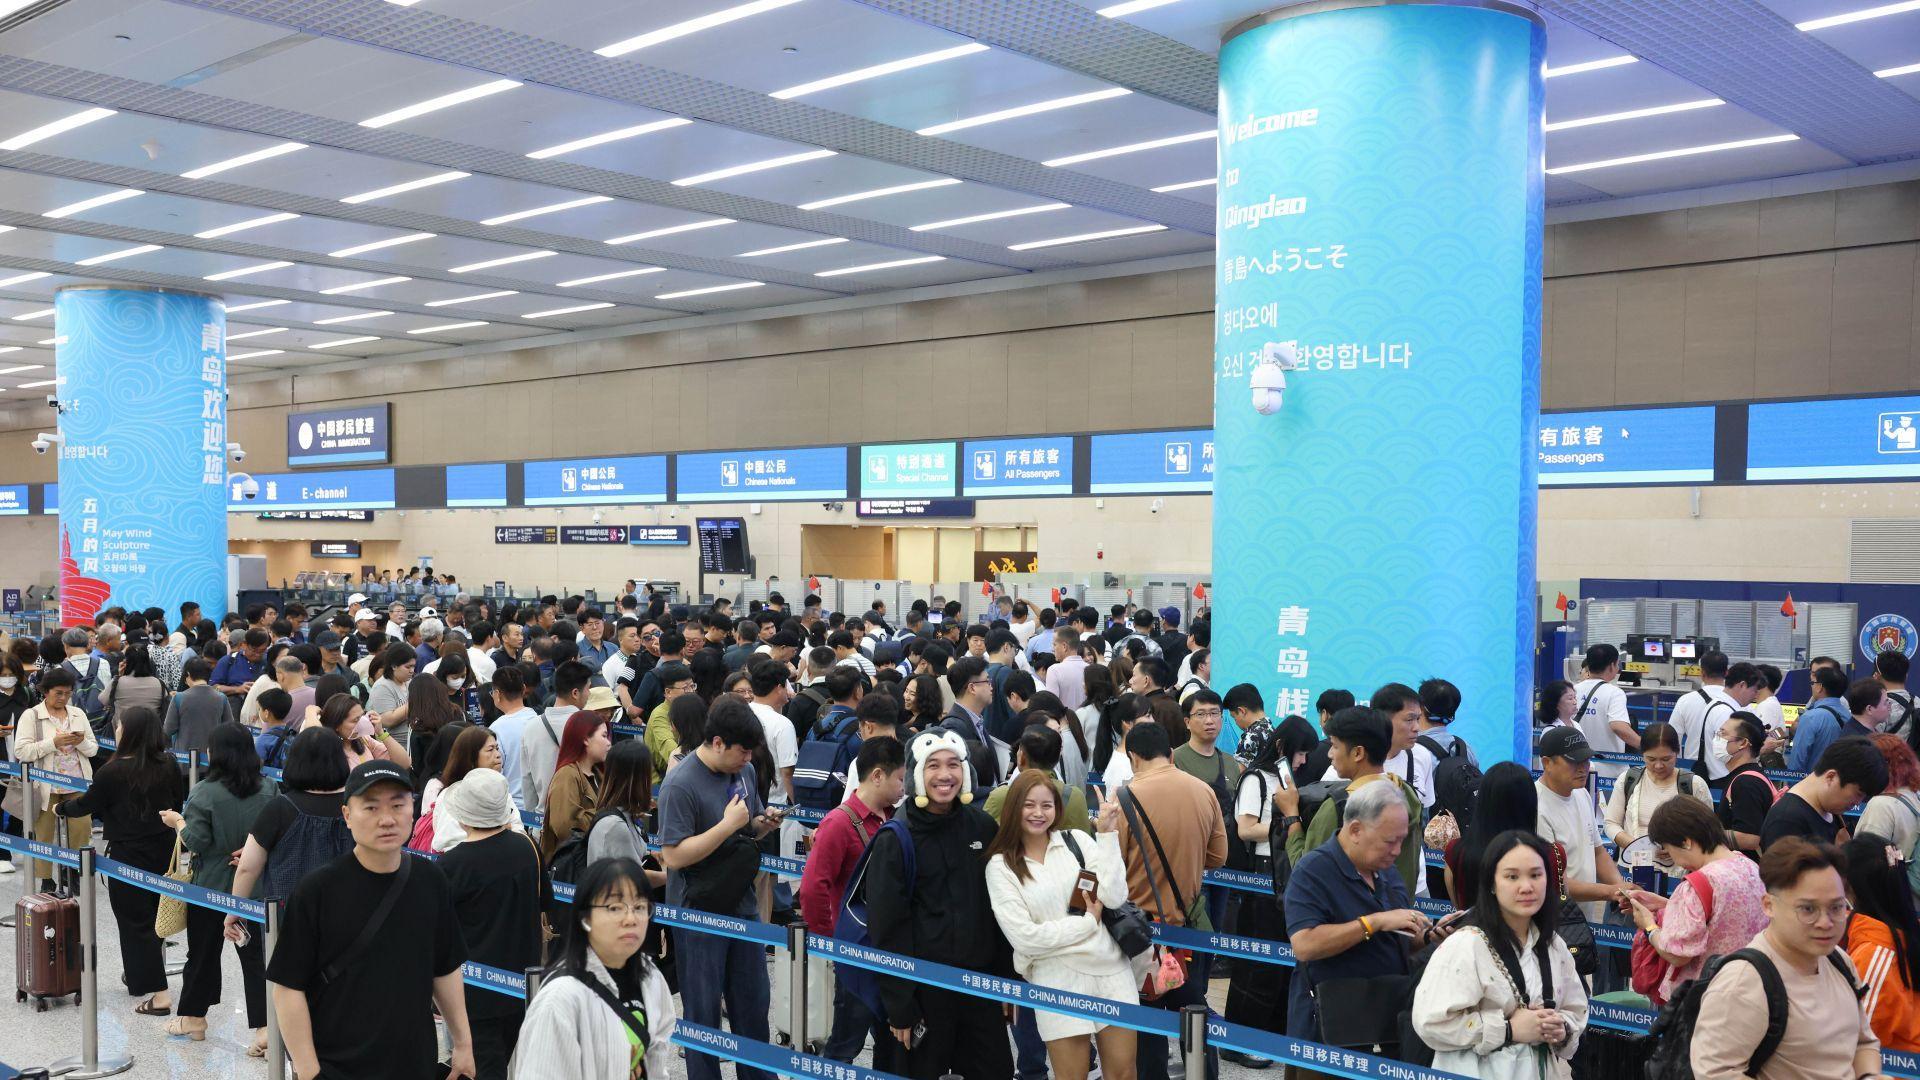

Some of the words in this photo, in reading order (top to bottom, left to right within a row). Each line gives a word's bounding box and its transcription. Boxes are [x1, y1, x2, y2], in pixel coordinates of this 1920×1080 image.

[1225, 108, 1319, 145] Welcome
[1226, 167, 1240, 188] to
[1225, 194, 1307, 230] Qingdao
[1224, 244, 1349, 286] 青島へようこそ
[1223, 302, 1278, 336] 칭다오에
[1222, 351, 1243, 378] 오신
[201, 322, 224, 485] 青岛欢迎您
[317, 417, 375, 438] 中国移民管理
[1539, 425, 1603, 448] 有旅客
[744, 459, 787, 474] 中国公民
[1005, 448, 1060, 466] 所有旅客
[1538, 452, 1605, 466] Passengers
[581, 466, 616, 480] 中国公民
[745, 477, 768, 486] Chinese
[769, 476, 796, 485] Nationals
[896, 473, 920, 484] Special
[922, 472, 949, 481] Channel
[1005, 469, 1015, 479] All
[1016, 469, 1060, 480] Passengers
[82, 498, 99, 574] 五月的风
[103, 529, 123, 540] May
[125, 528, 152, 538] Wind
[102, 541, 151, 552] Sculpture
[1275, 605, 1310, 718] 青岛栈
[364, 769, 400, 778] BALENCIAGA
[1213, 870, 1236, 882] CHINA
[206, 891, 236, 908] 中国移民管理
[655, 906, 678, 920] 民管理
[682, 911, 702, 924] CHINA
[702, 916, 747, 932] IMMIGRATION
[1210, 935, 1271, 955] 中国移民管理
[1278, 946, 1295, 958] CHI
[839, 944, 862, 959] CHINA
[864, 951, 915, 972] IMMIGRATION
[486, 971, 507, 985] CHINA
[962, 973, 1022, 997] 中国移民管理
[1028, 988, 1057, 1004] CHINA
[1058, 996, 1120, 1017] IMMIGRATION
[682, 1028, 738, 1051] IMMIGRATION
[790, 1054, 857, 1080] 中国移民管理
[1290, 1042, 1369, 1073] 中国移民管理
[1880, 1053, 1918, 1070] HINA
